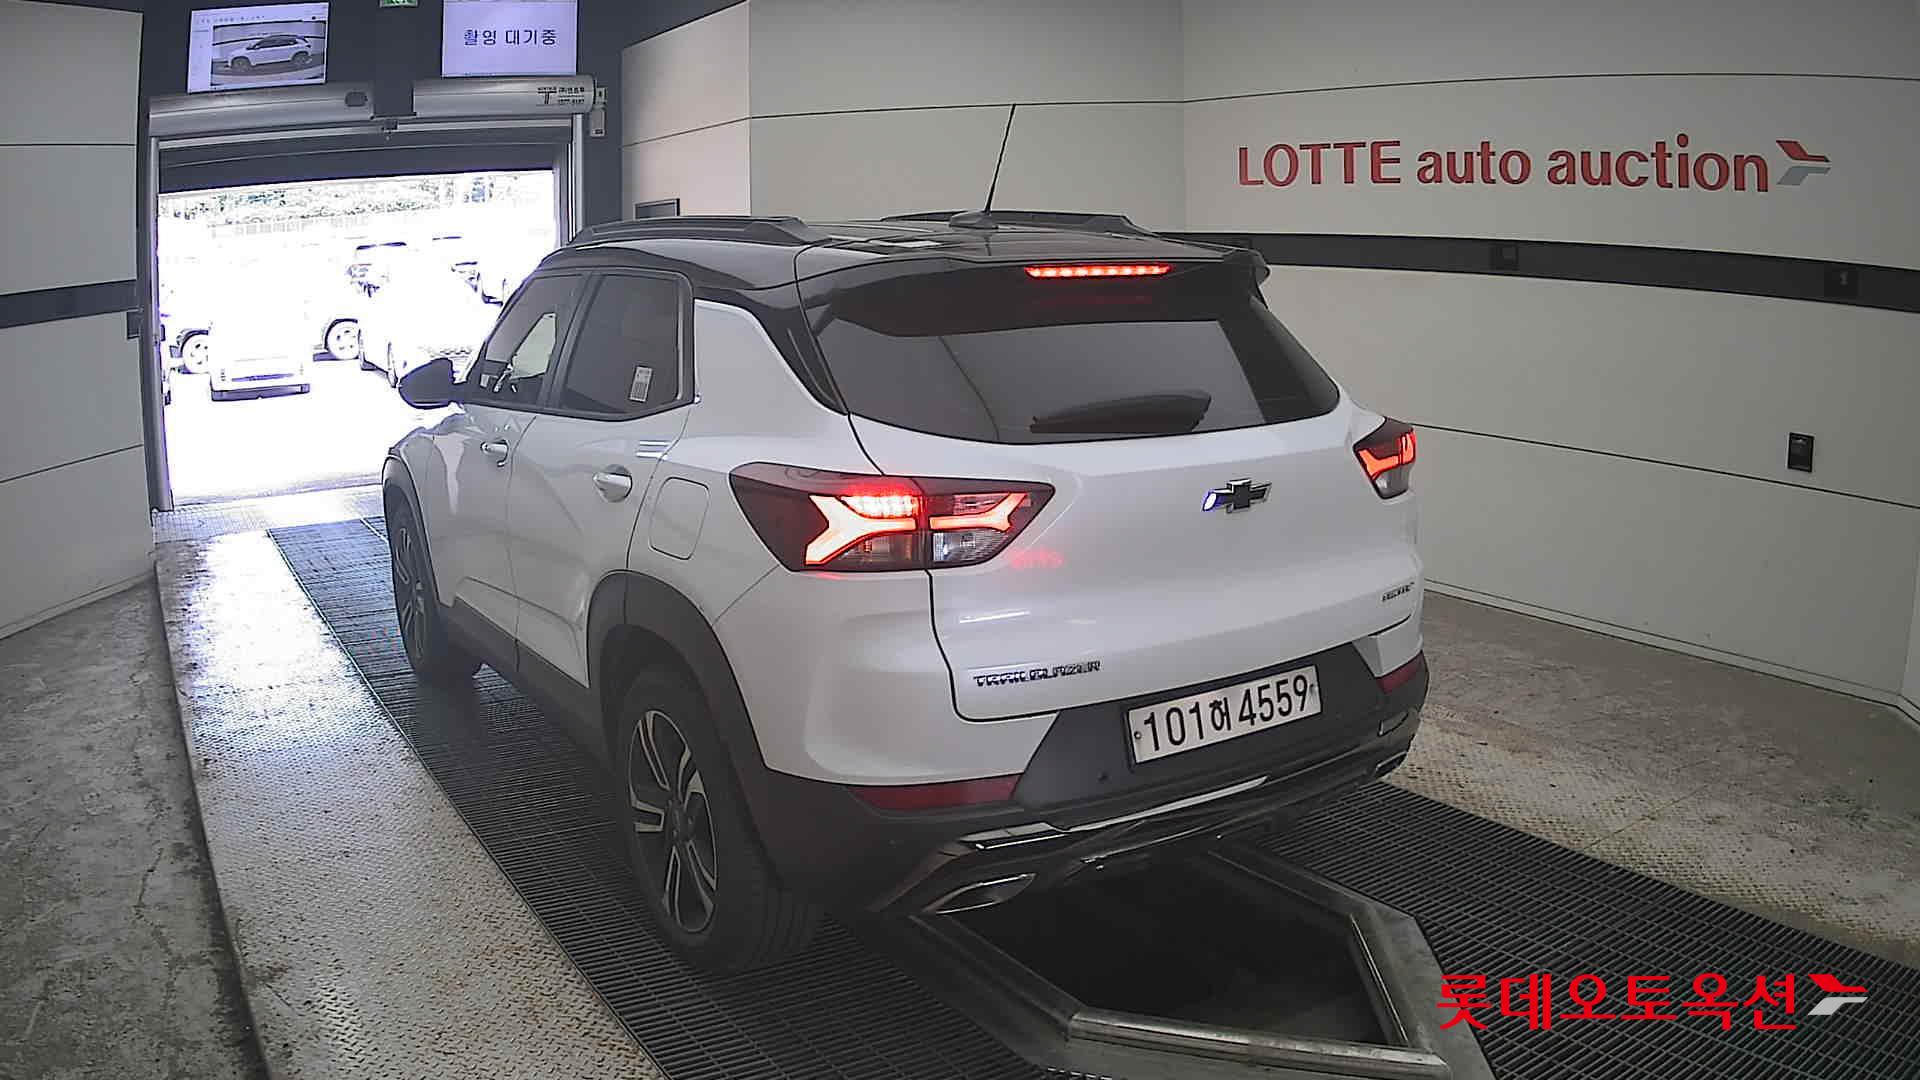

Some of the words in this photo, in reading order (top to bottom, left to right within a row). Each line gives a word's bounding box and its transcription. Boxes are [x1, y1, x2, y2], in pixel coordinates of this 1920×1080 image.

[463, 29, 497, 46] 촬영
[505, 29, 557, 46] 대기중
[1238, 140, 1401, 187] LOTTE
[1417, 141, 1532, 186] auto
[1547, 134, 1769, 192] auction
[1238, 674, 1308, 726] 4559
